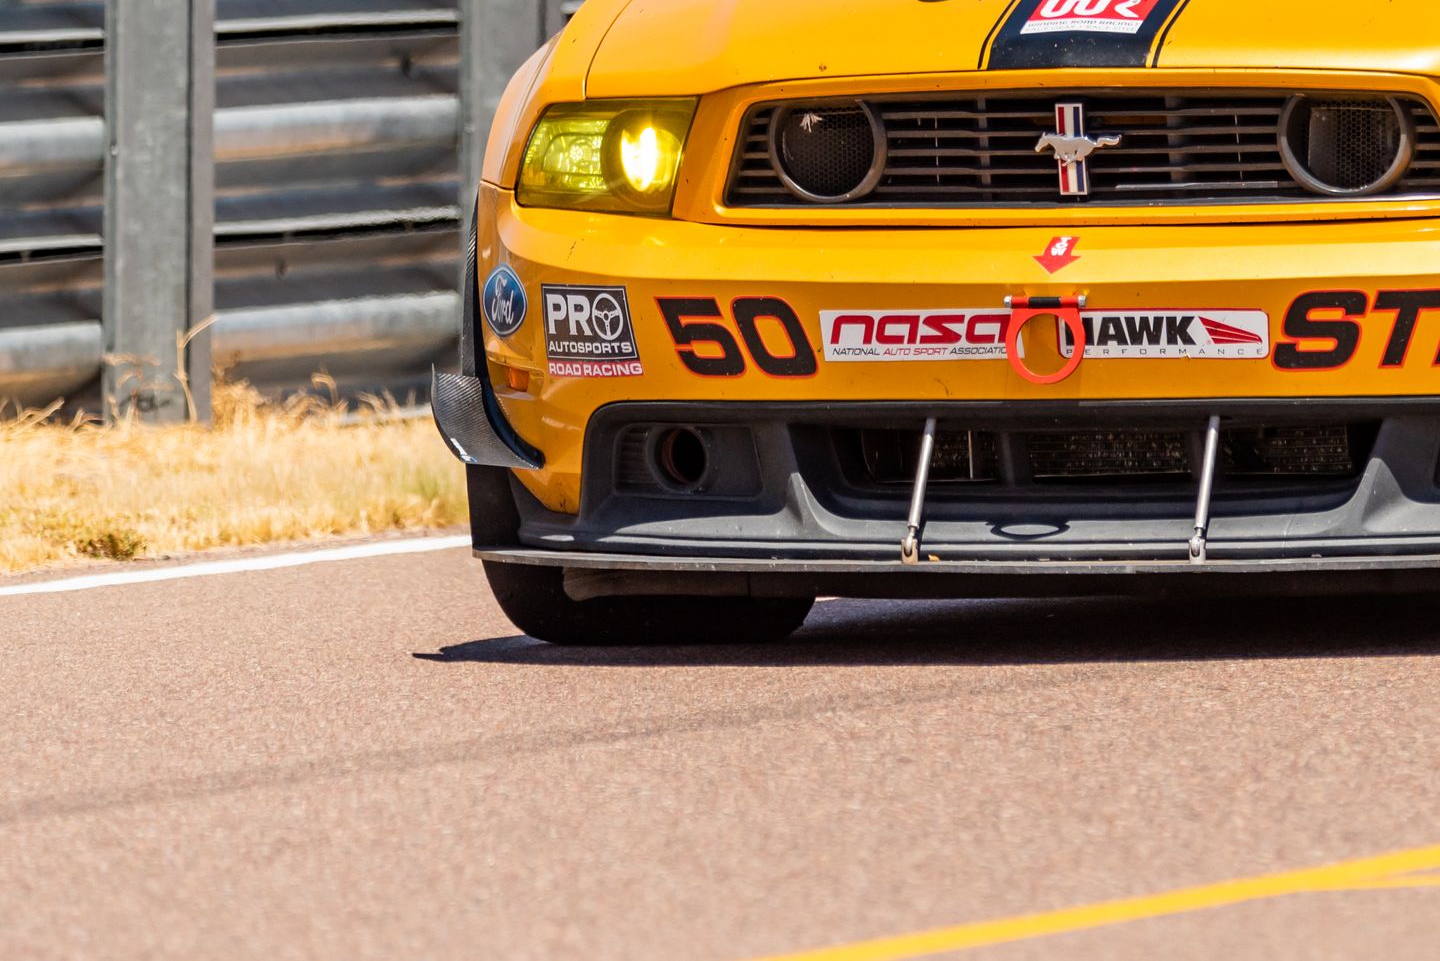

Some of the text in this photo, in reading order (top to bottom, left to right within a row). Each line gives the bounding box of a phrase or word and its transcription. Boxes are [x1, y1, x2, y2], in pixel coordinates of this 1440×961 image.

[1050, 237, 1071, 256] TOW
[653, 295, 819, 379] 50
[1065, 315, 1196, 346] HAWK
[549, 341, 633, 355] AUTOSPORTS
[832, 347, 880, 356] NATIONAL
[883, 347, 911, 356] AUTO
[913, 347, 949, 356] SPORT
[1066, 348, 1263, 356] PERFORMANCE
[549, 362, 643, 376] ROAD RACING
